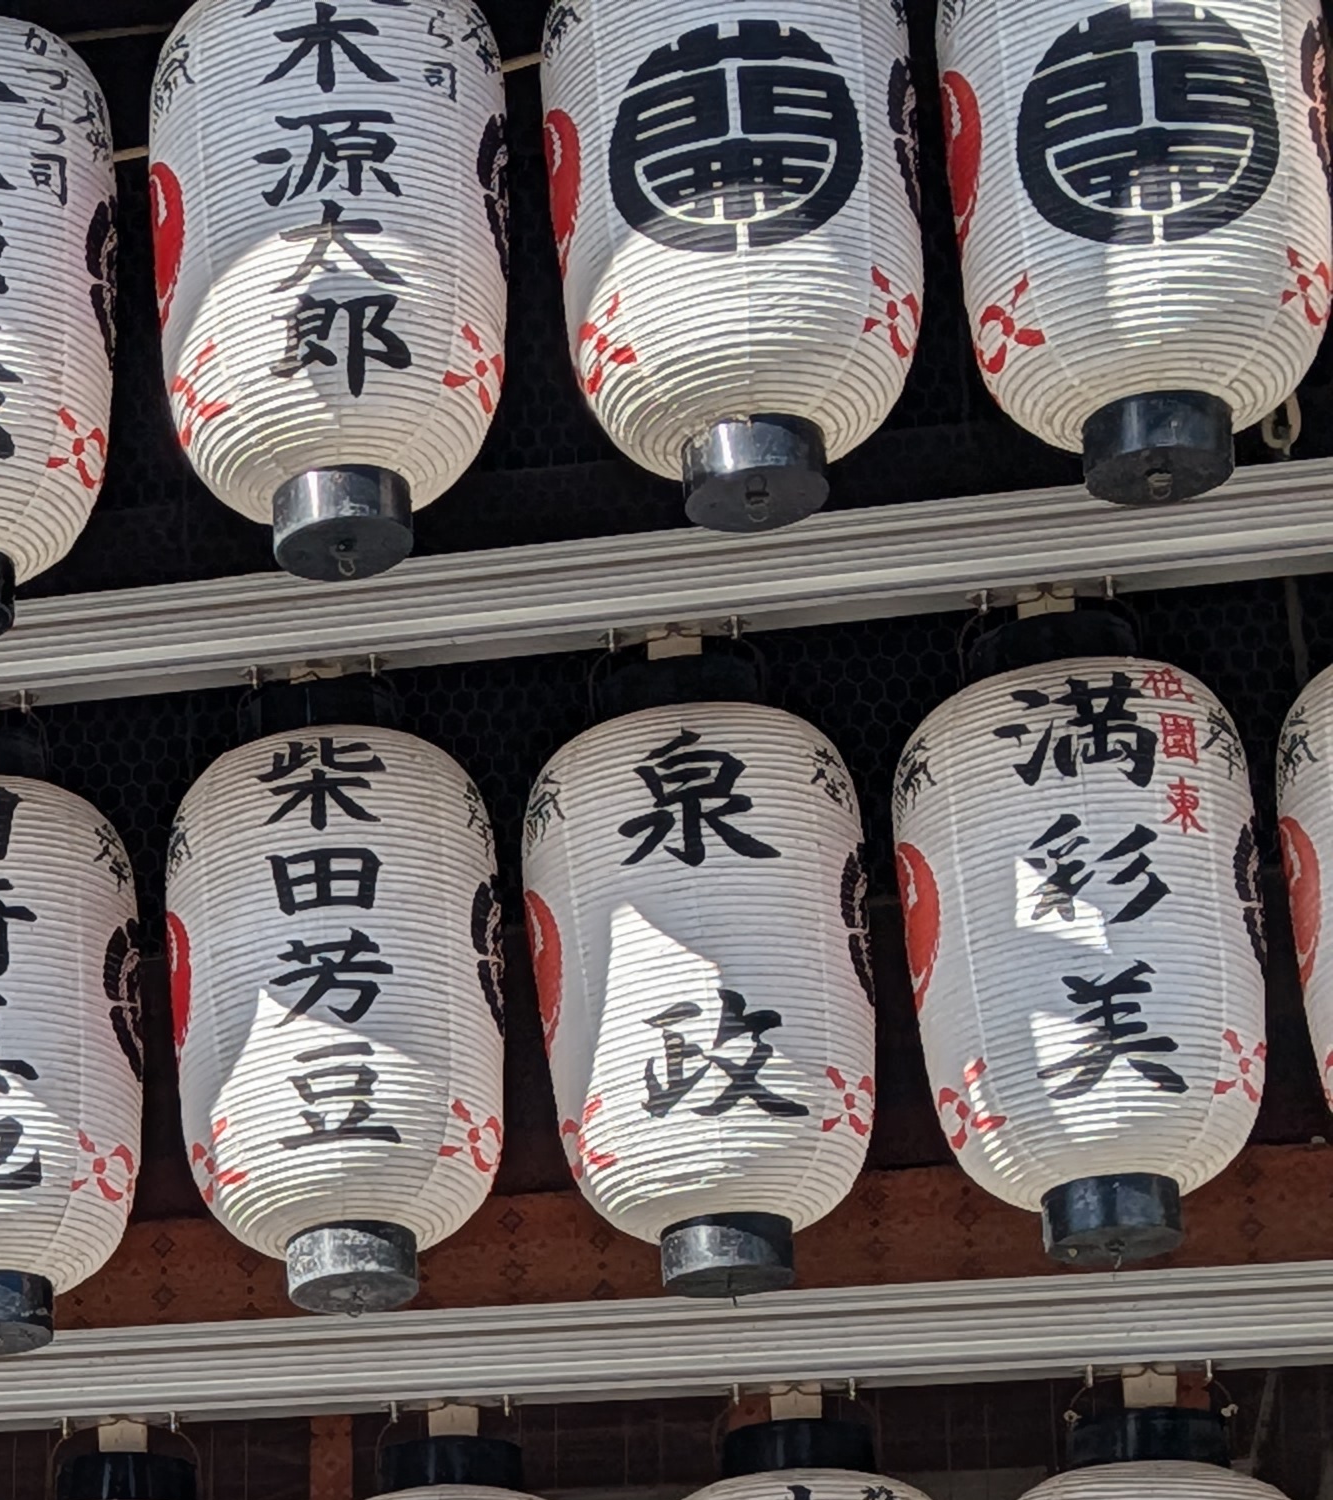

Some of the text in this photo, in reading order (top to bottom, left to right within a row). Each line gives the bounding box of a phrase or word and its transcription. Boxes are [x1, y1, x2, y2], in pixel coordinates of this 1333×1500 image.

[253, 0, 413, 397] 木源太郎
[256, 736, 401, 1150] 柴田芳豆
[618, 728, 810, 1118] 泉政
[994, 672, 1188, 1099] 満彩美
